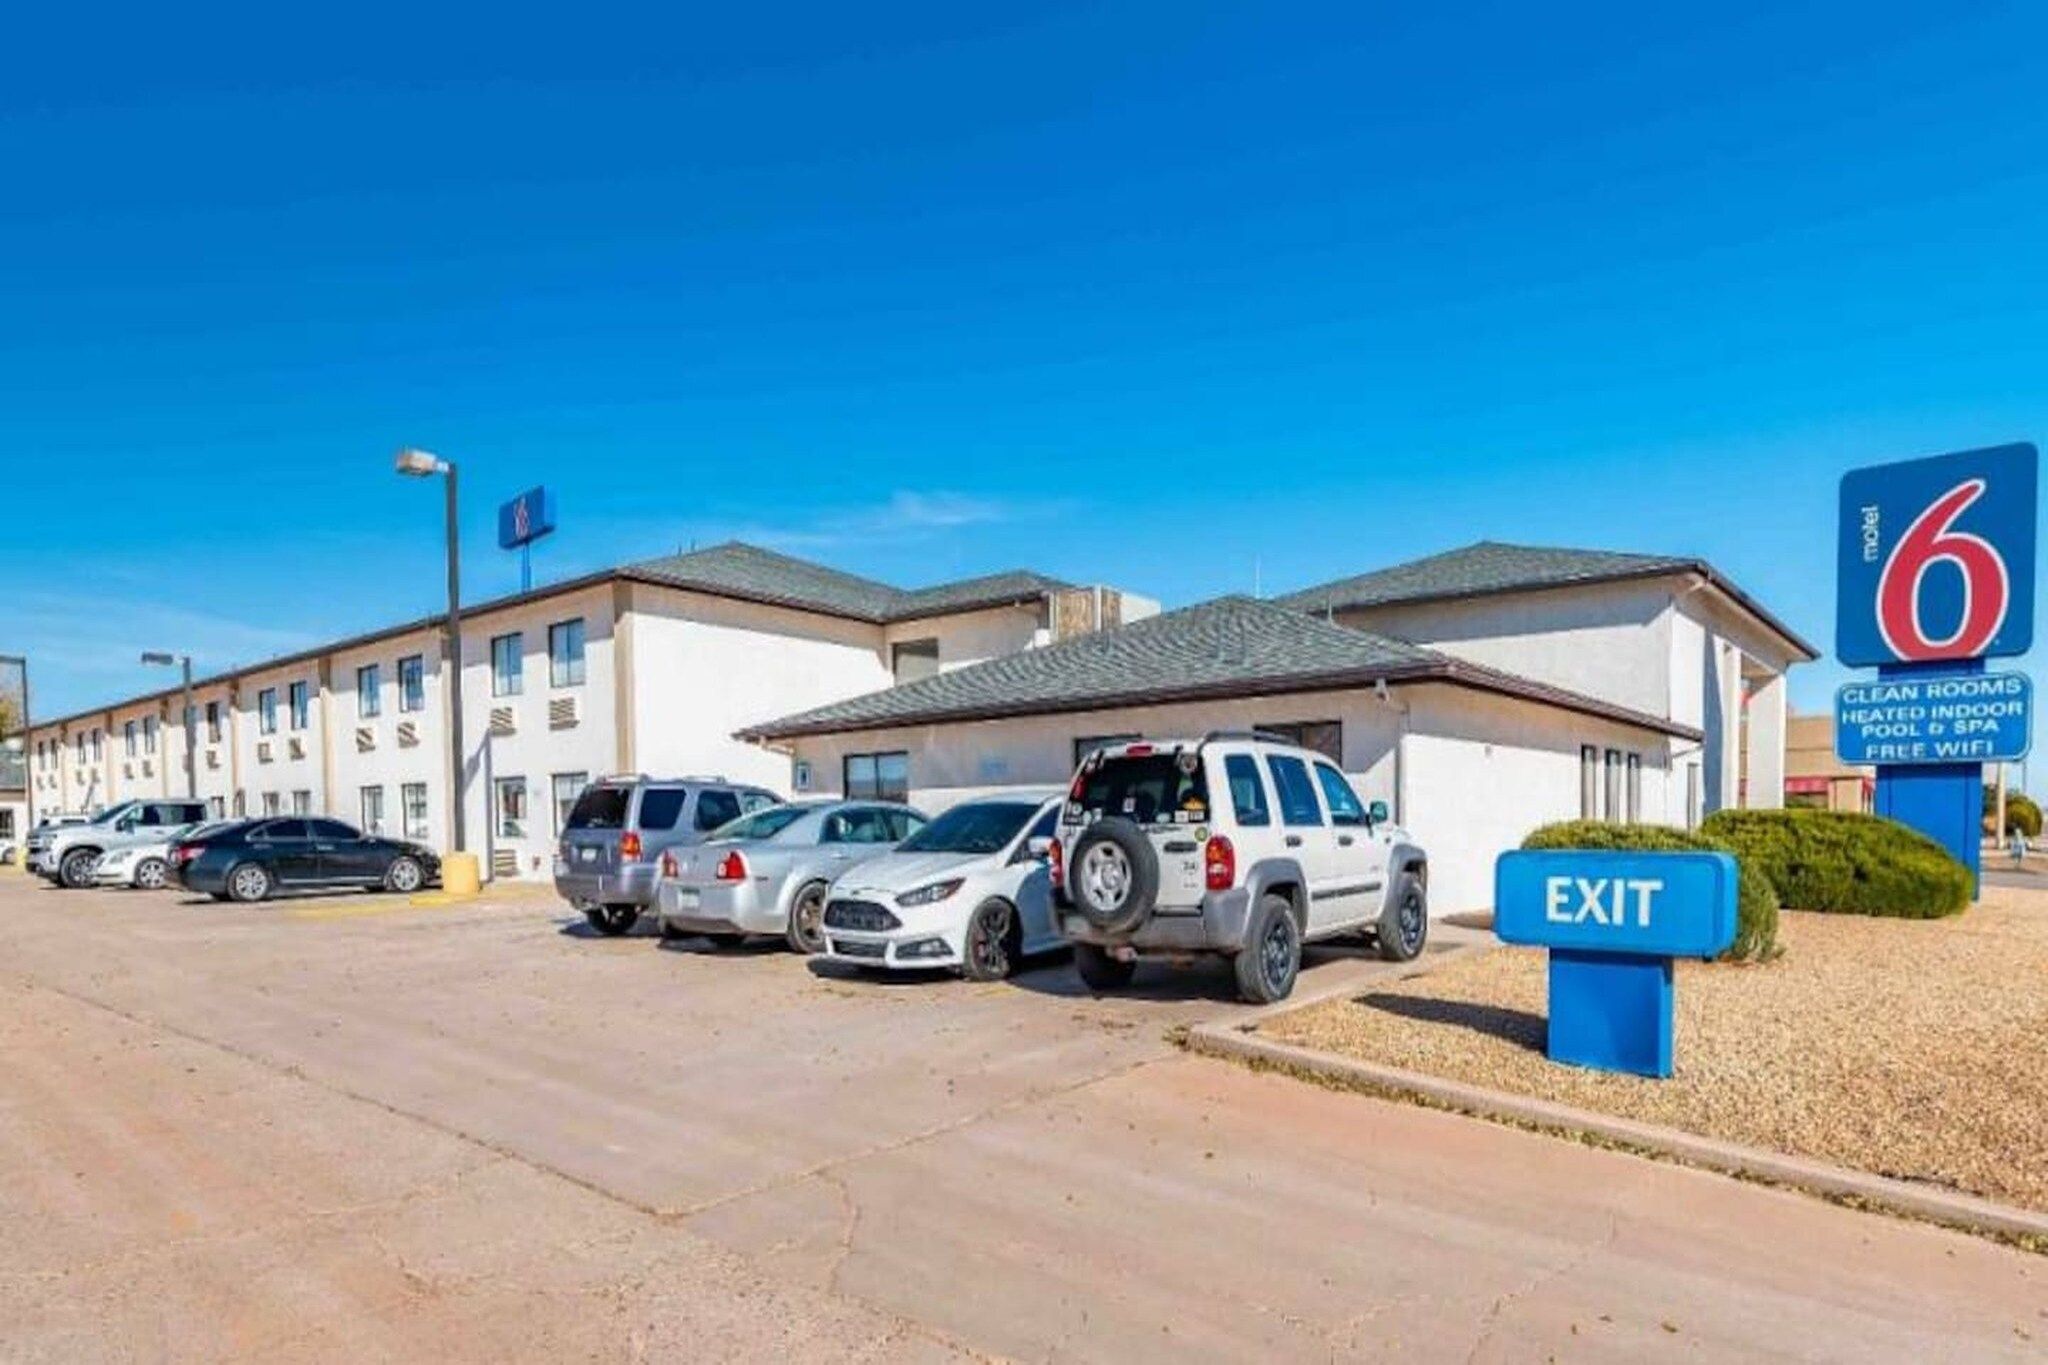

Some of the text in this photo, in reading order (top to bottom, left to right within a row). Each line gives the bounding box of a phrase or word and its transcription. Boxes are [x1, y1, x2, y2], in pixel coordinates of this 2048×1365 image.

[1861, 478, 2010, 661] motel 6
[1843, 678, 2022, 704] CLEAN ROOMS
[1842, 701, 2023, 724] HEATED INDOOR
[1862, 719, 1999, 738] POOL & SPA
[1866, 740, 1994, 759] FREE WIFI
[1546, 876, 1664, 927] EXIT
